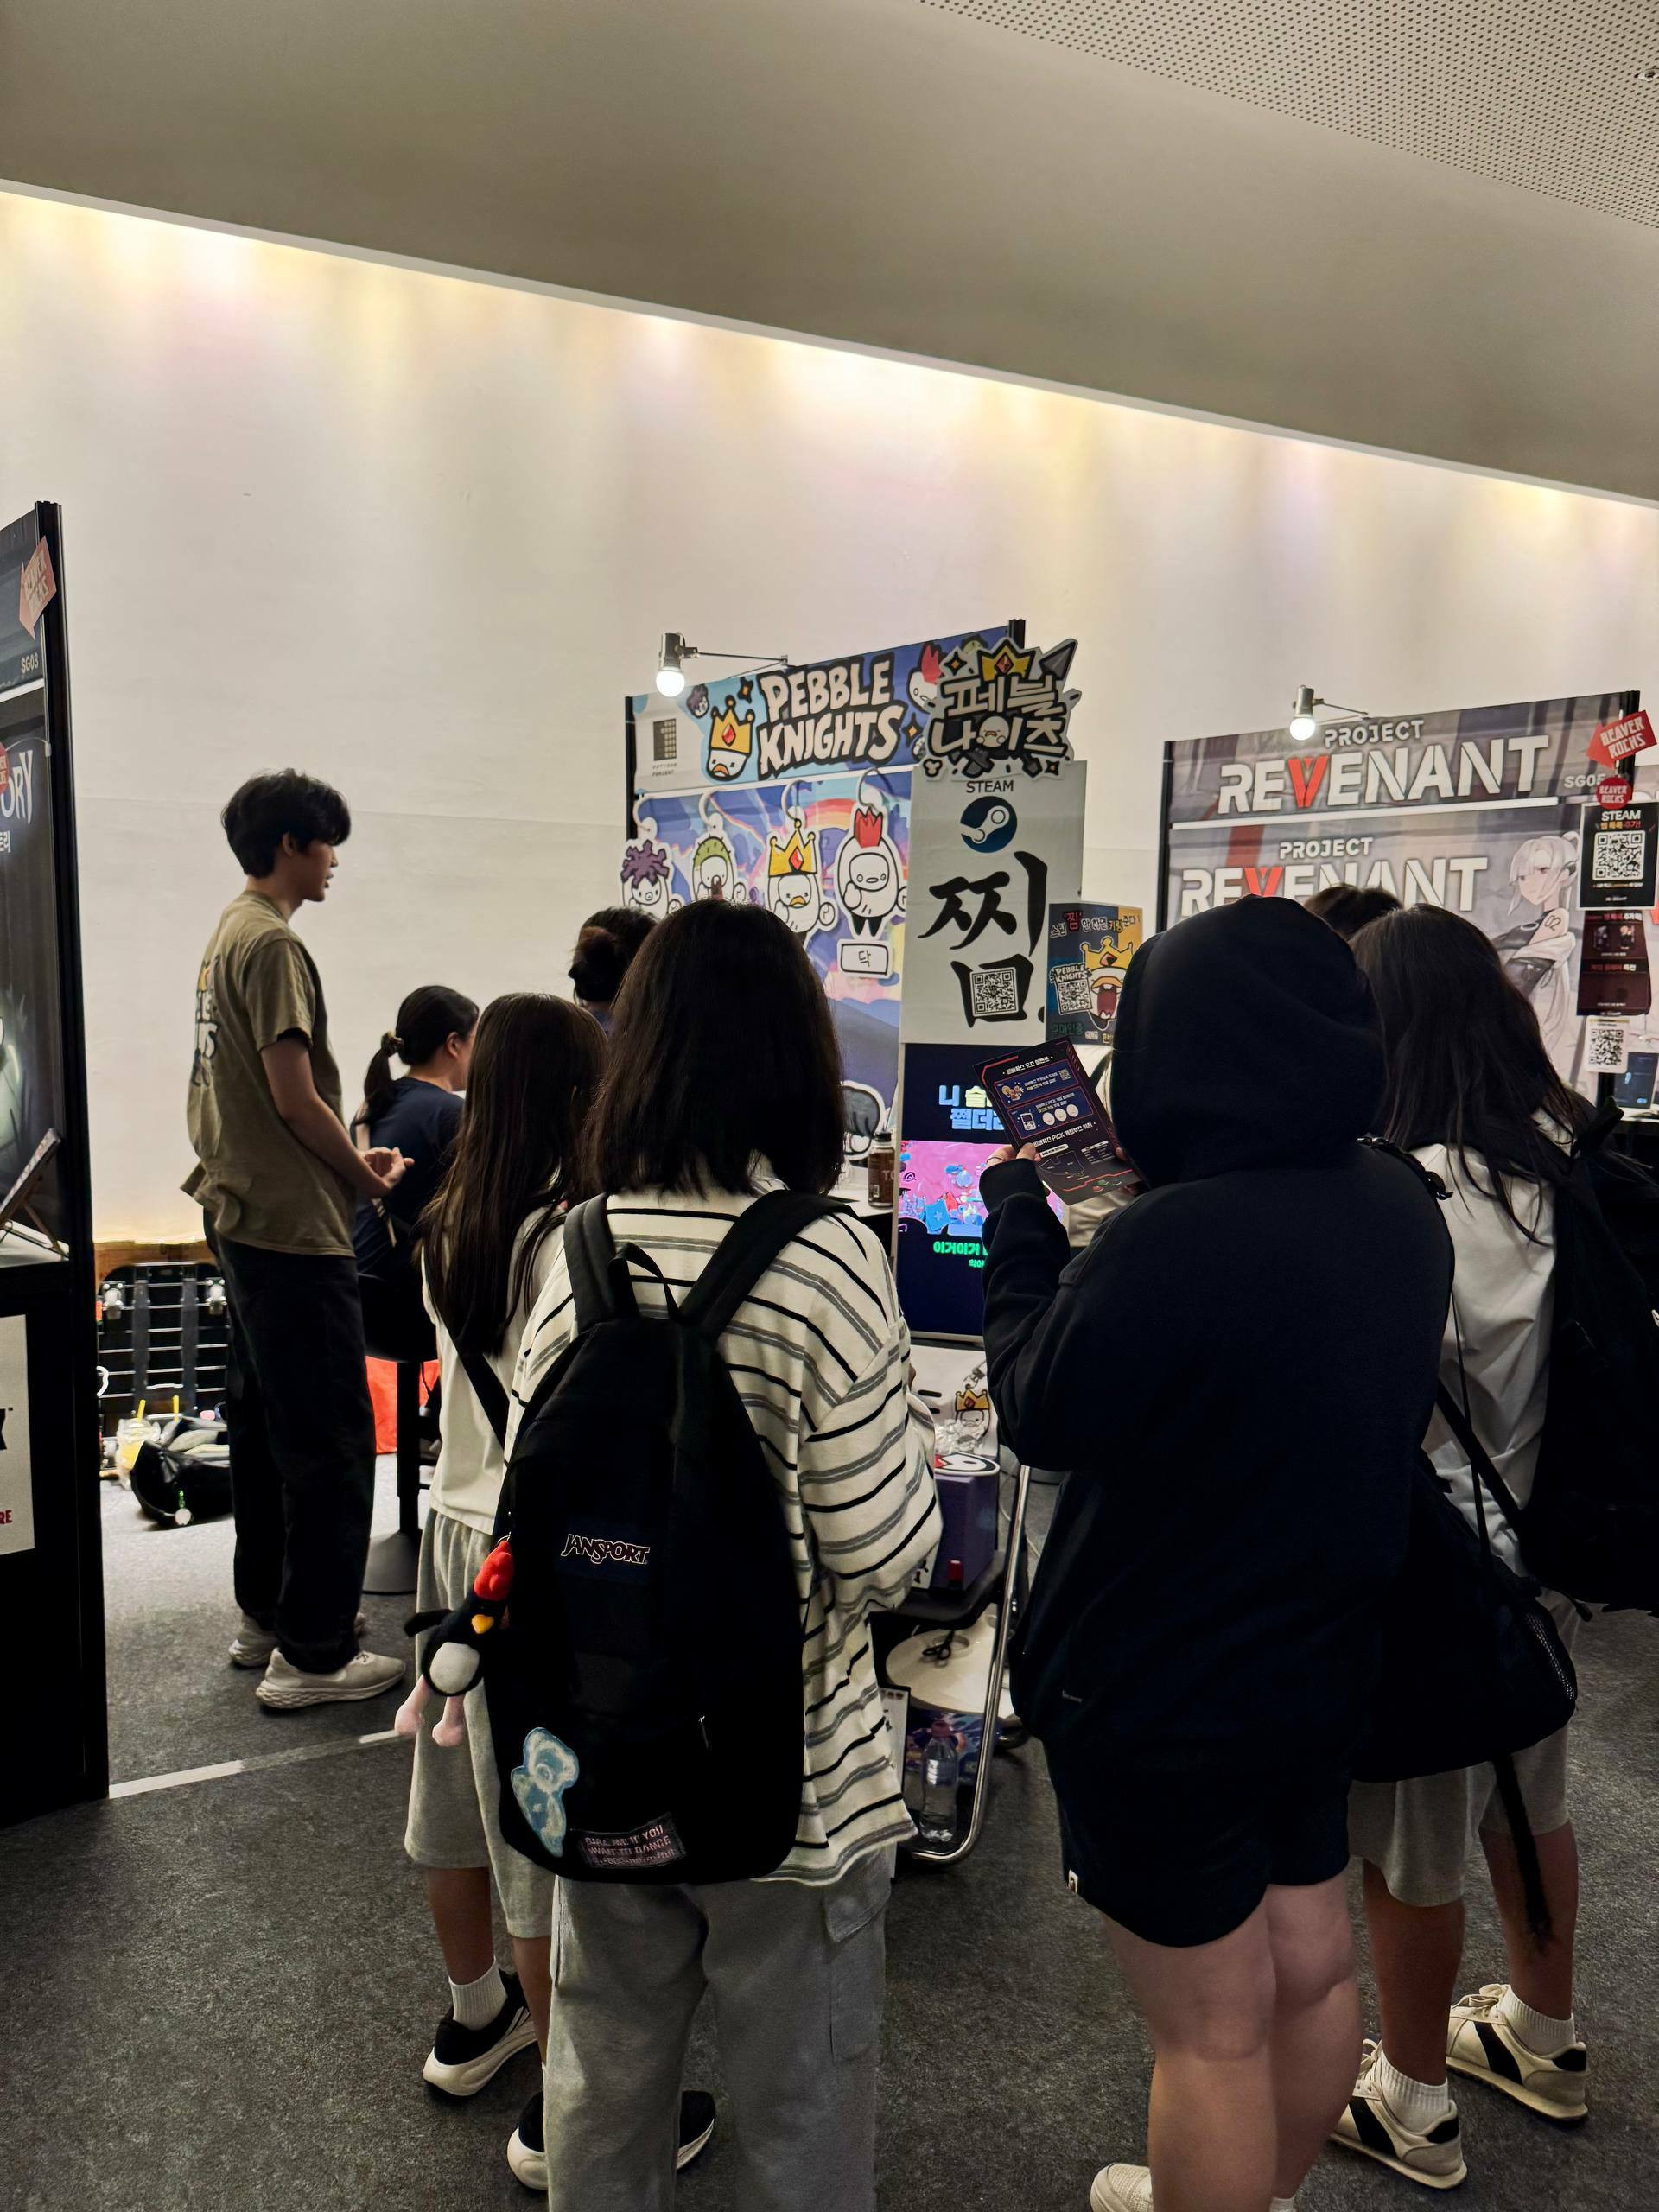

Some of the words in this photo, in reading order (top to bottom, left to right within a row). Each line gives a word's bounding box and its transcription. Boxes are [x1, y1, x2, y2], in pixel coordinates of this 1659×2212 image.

[21, 652, 39, 674] SG03
[760, 660, 891, 723] PEBBLE
[942, 674, 1067, 718] 페블
[759, 704, 905, 775] KNIGHTS
[931, 715, 1068, 755] 나이츠
[1325, 720, 1424, 747] PROJECT
[1599, 716, 1644, 747] BEAVER
[966, 780, 1014, 793] STEAM
[1217, 735, 1549, 814] REVENANT
[1601, 810, 1641, 822] STEAM
[1279, 837, 1373, 860] PROJECT
[1055, 964, 1084, 976] PEBBLE
[1056, 970, 1088, 982] KNIGHTS
[561, 1534, 650, 1564] JANSPORT
[634, 1835, 671, 1854] DANCE
[641, 1824, 664, 1840] YOU
